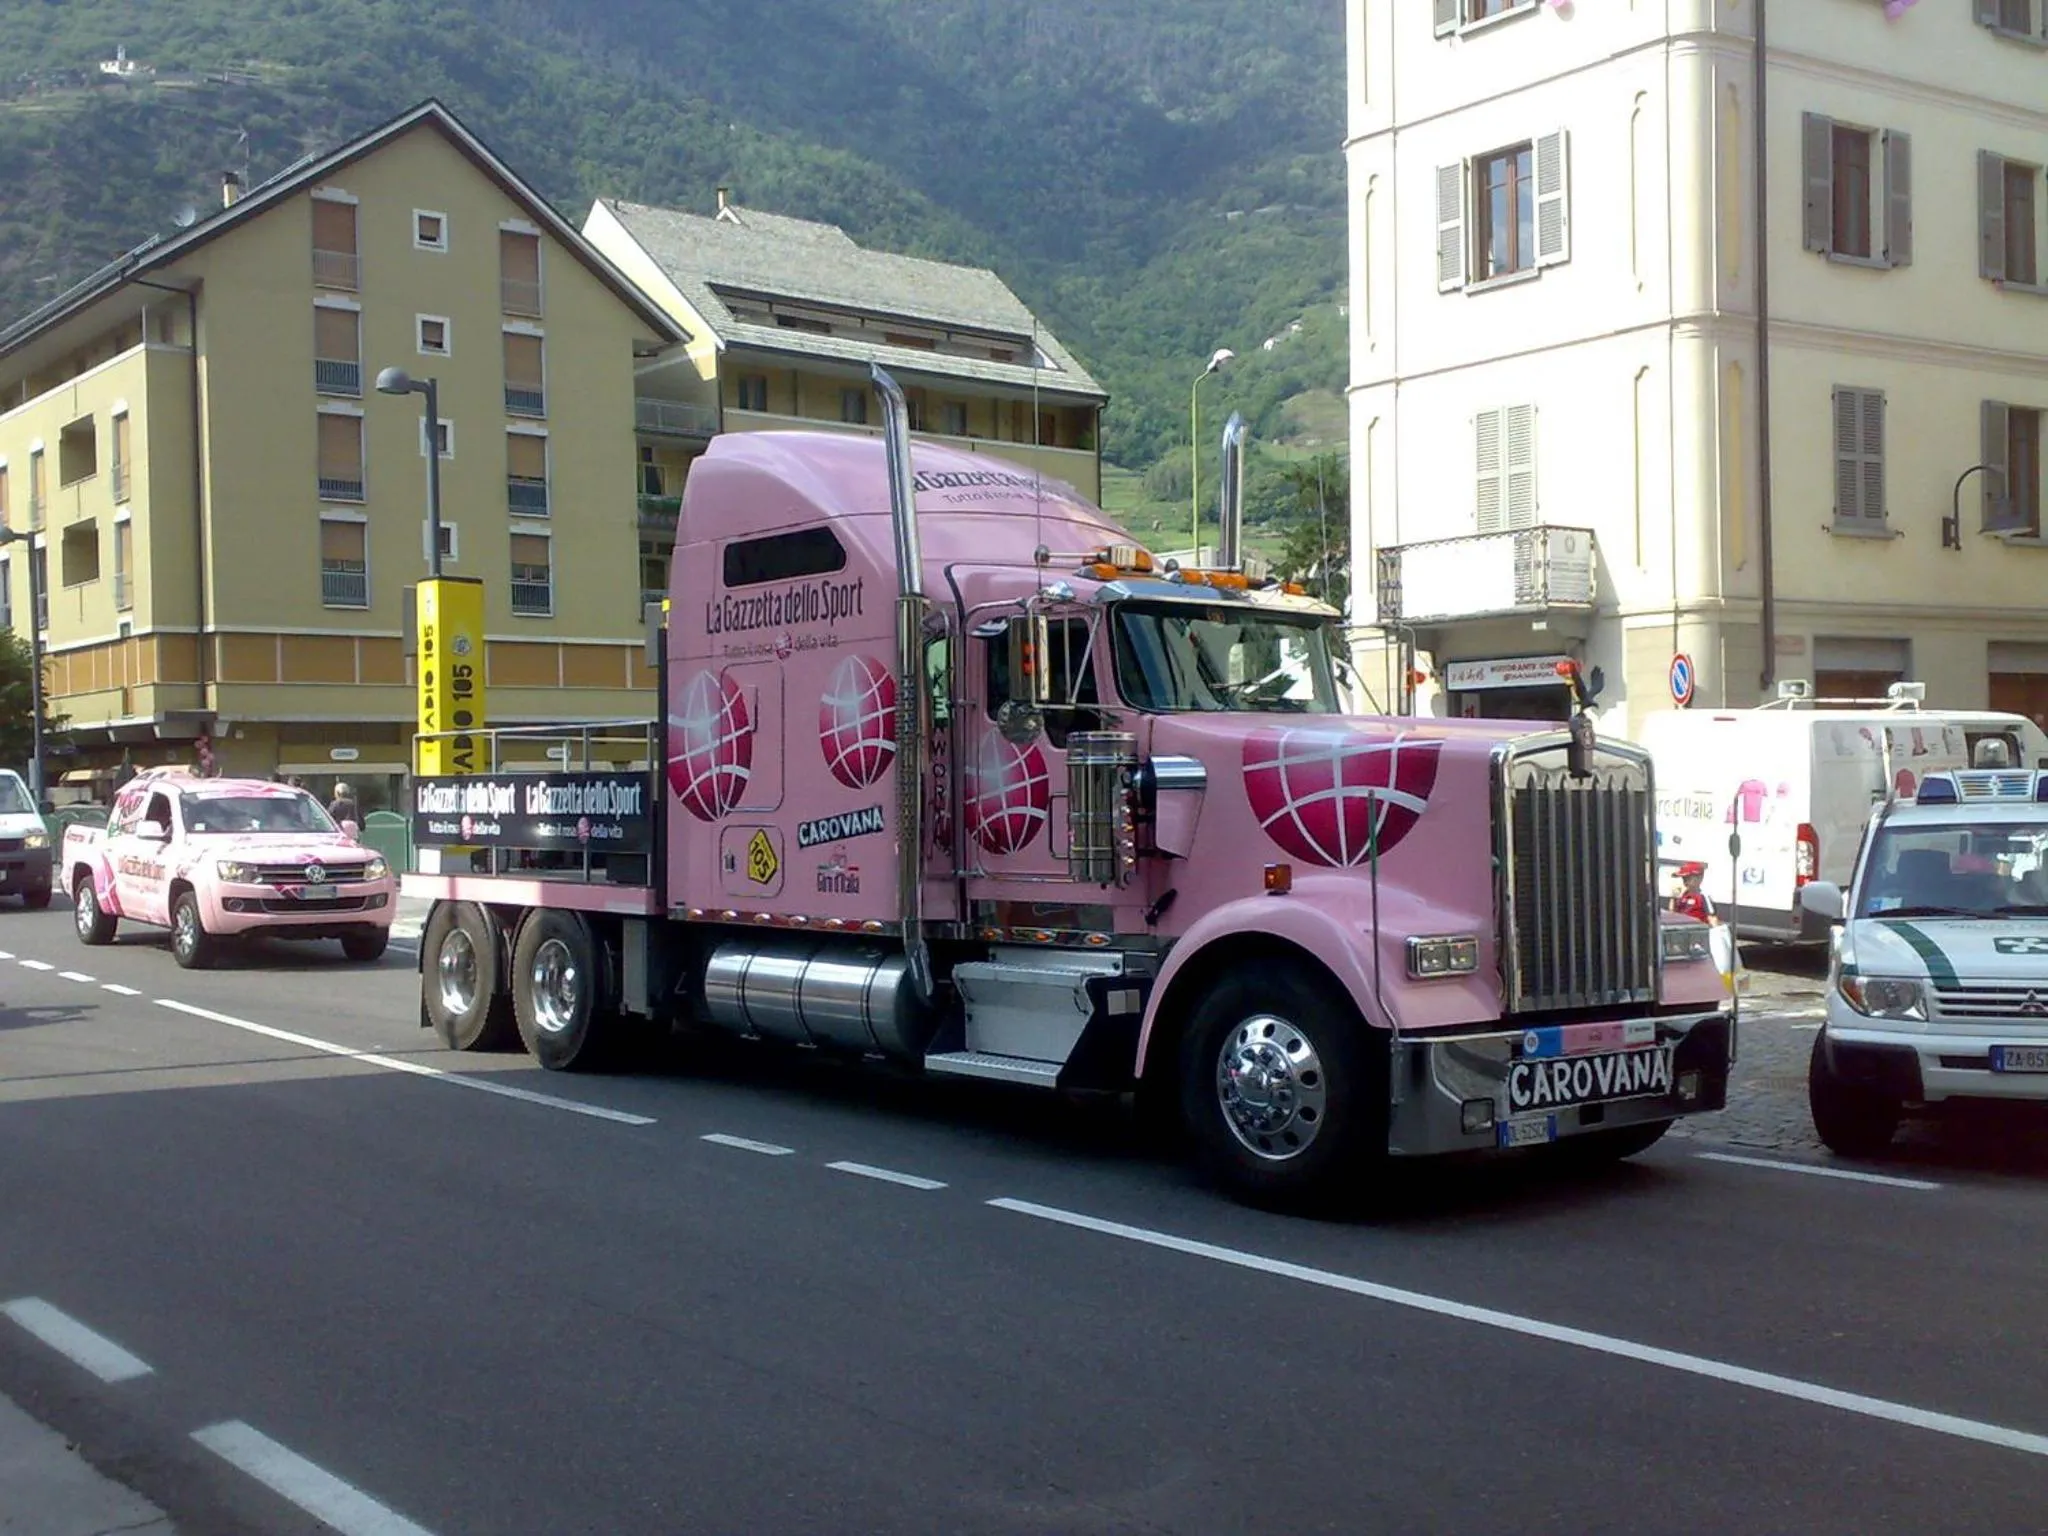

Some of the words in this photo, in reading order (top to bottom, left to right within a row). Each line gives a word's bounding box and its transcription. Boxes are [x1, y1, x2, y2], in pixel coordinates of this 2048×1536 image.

[723, 591, 782, 632] Gazzetta
[784, 582, 819, 625] dello
[820, 576, 864, 627] Sport
[452, 664, 474, 701] 105
[453, 709, 474, 775] ADIO
[488, 782, 516, 820] Sport
[539, 780, 582, 815] Gazzetta
[583, 780, 609, 815] dello
[609, 780, 641, 821] Sport
[799, 807, 884, 846] CAROVANA
[750, 841, 770, 879] 105
[1510, 1049, 1667, 1107] CAROVANA
